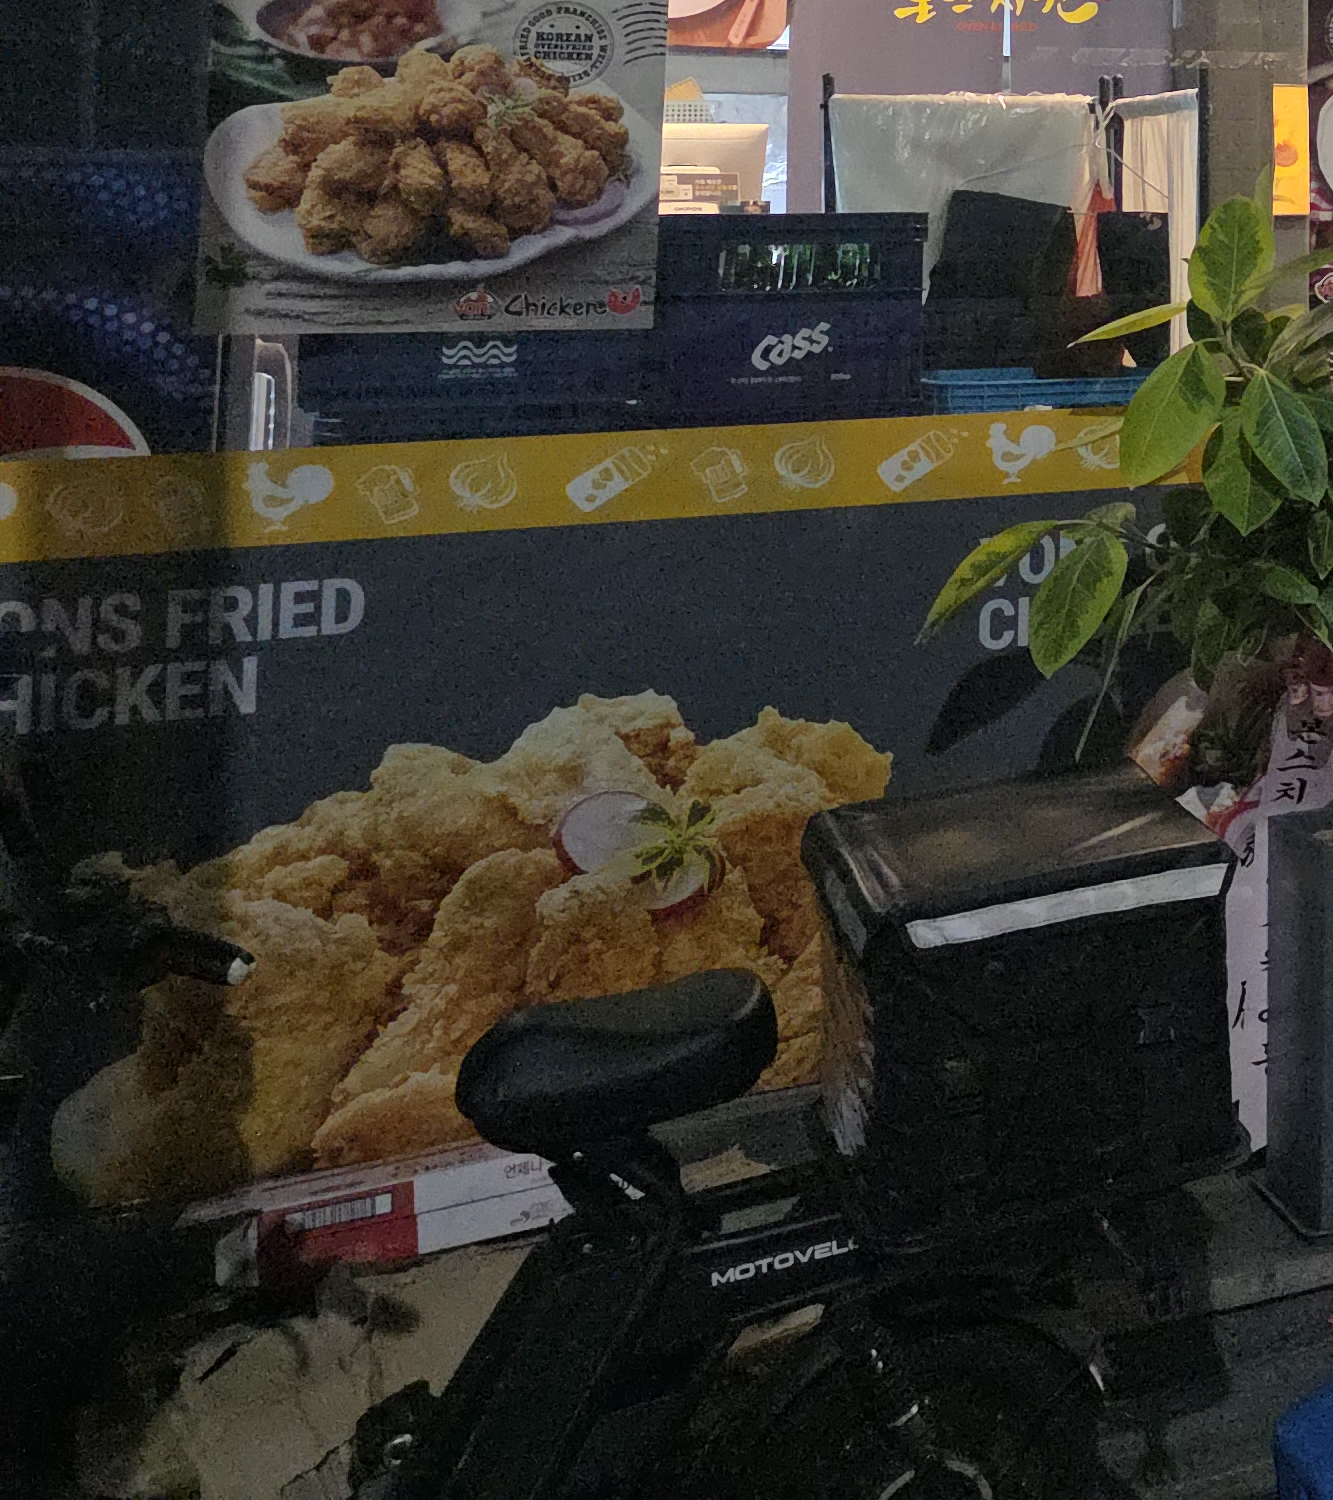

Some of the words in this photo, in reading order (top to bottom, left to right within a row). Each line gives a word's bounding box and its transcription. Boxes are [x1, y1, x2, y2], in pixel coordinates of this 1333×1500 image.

[534, 50, 594, 61] CHICKEN
[535, 32, 594, 43] KOREAN
[0, 588, 142, 659] ONS
[164, 577, 366, 650] FRIED
[0, 655, 258, 736] HICKEN
